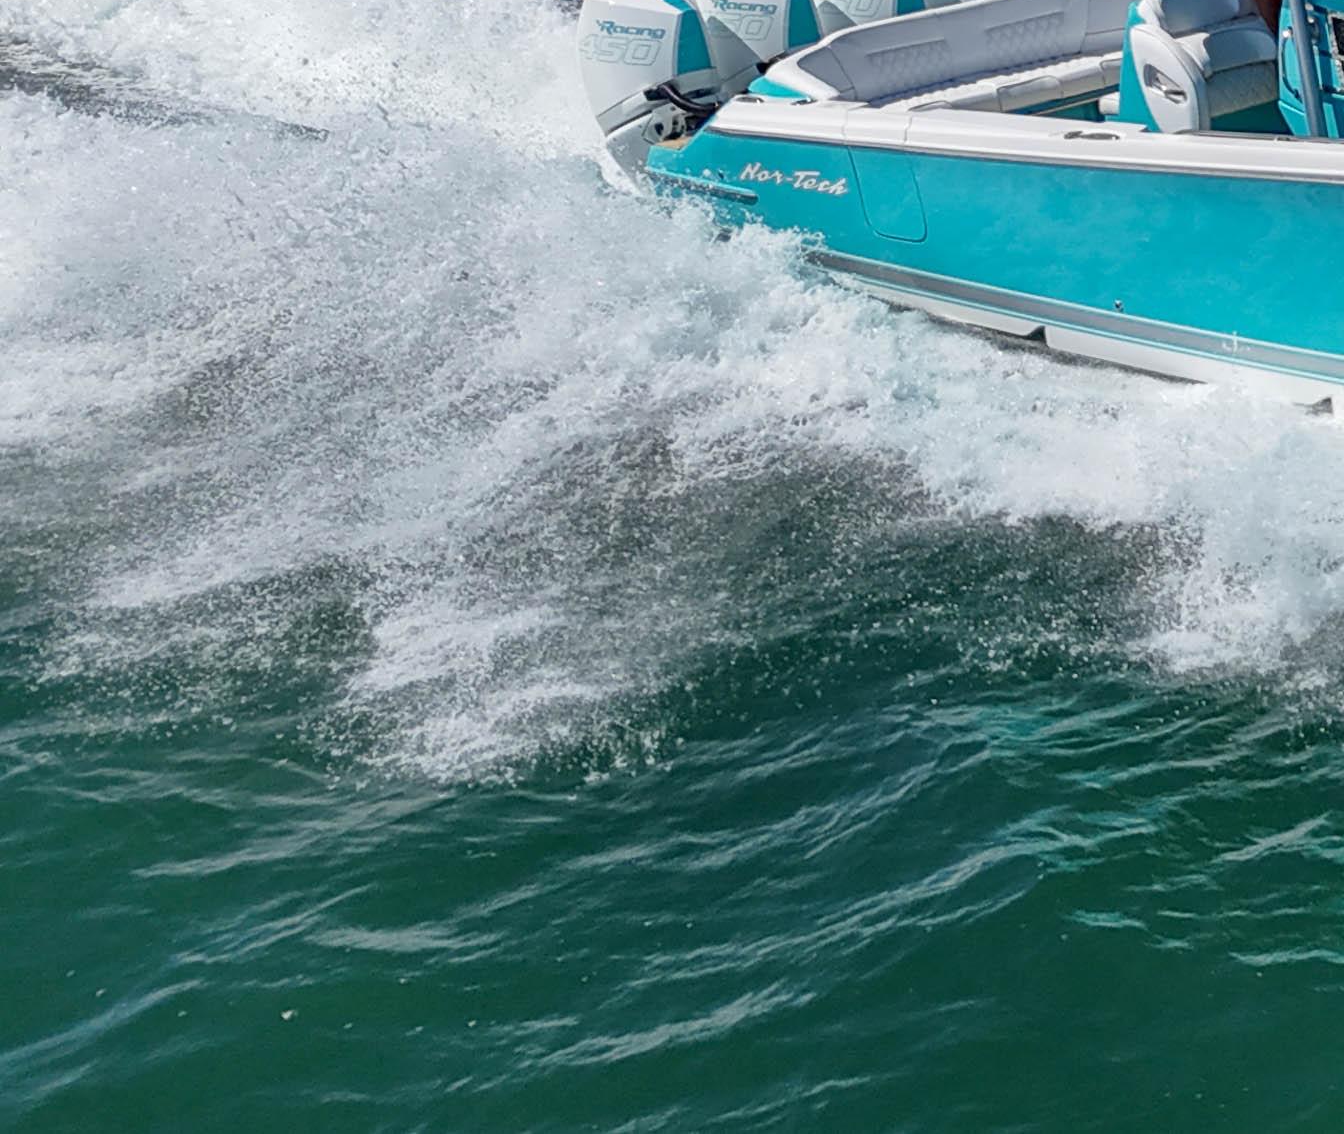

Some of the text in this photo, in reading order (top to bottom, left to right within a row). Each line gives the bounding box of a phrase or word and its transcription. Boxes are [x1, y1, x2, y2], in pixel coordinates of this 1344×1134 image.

[595, 19, 666, 39] Racing
[578, 34, 663, 66] 450
[739, 161, 848, 195] Nor-Tech
